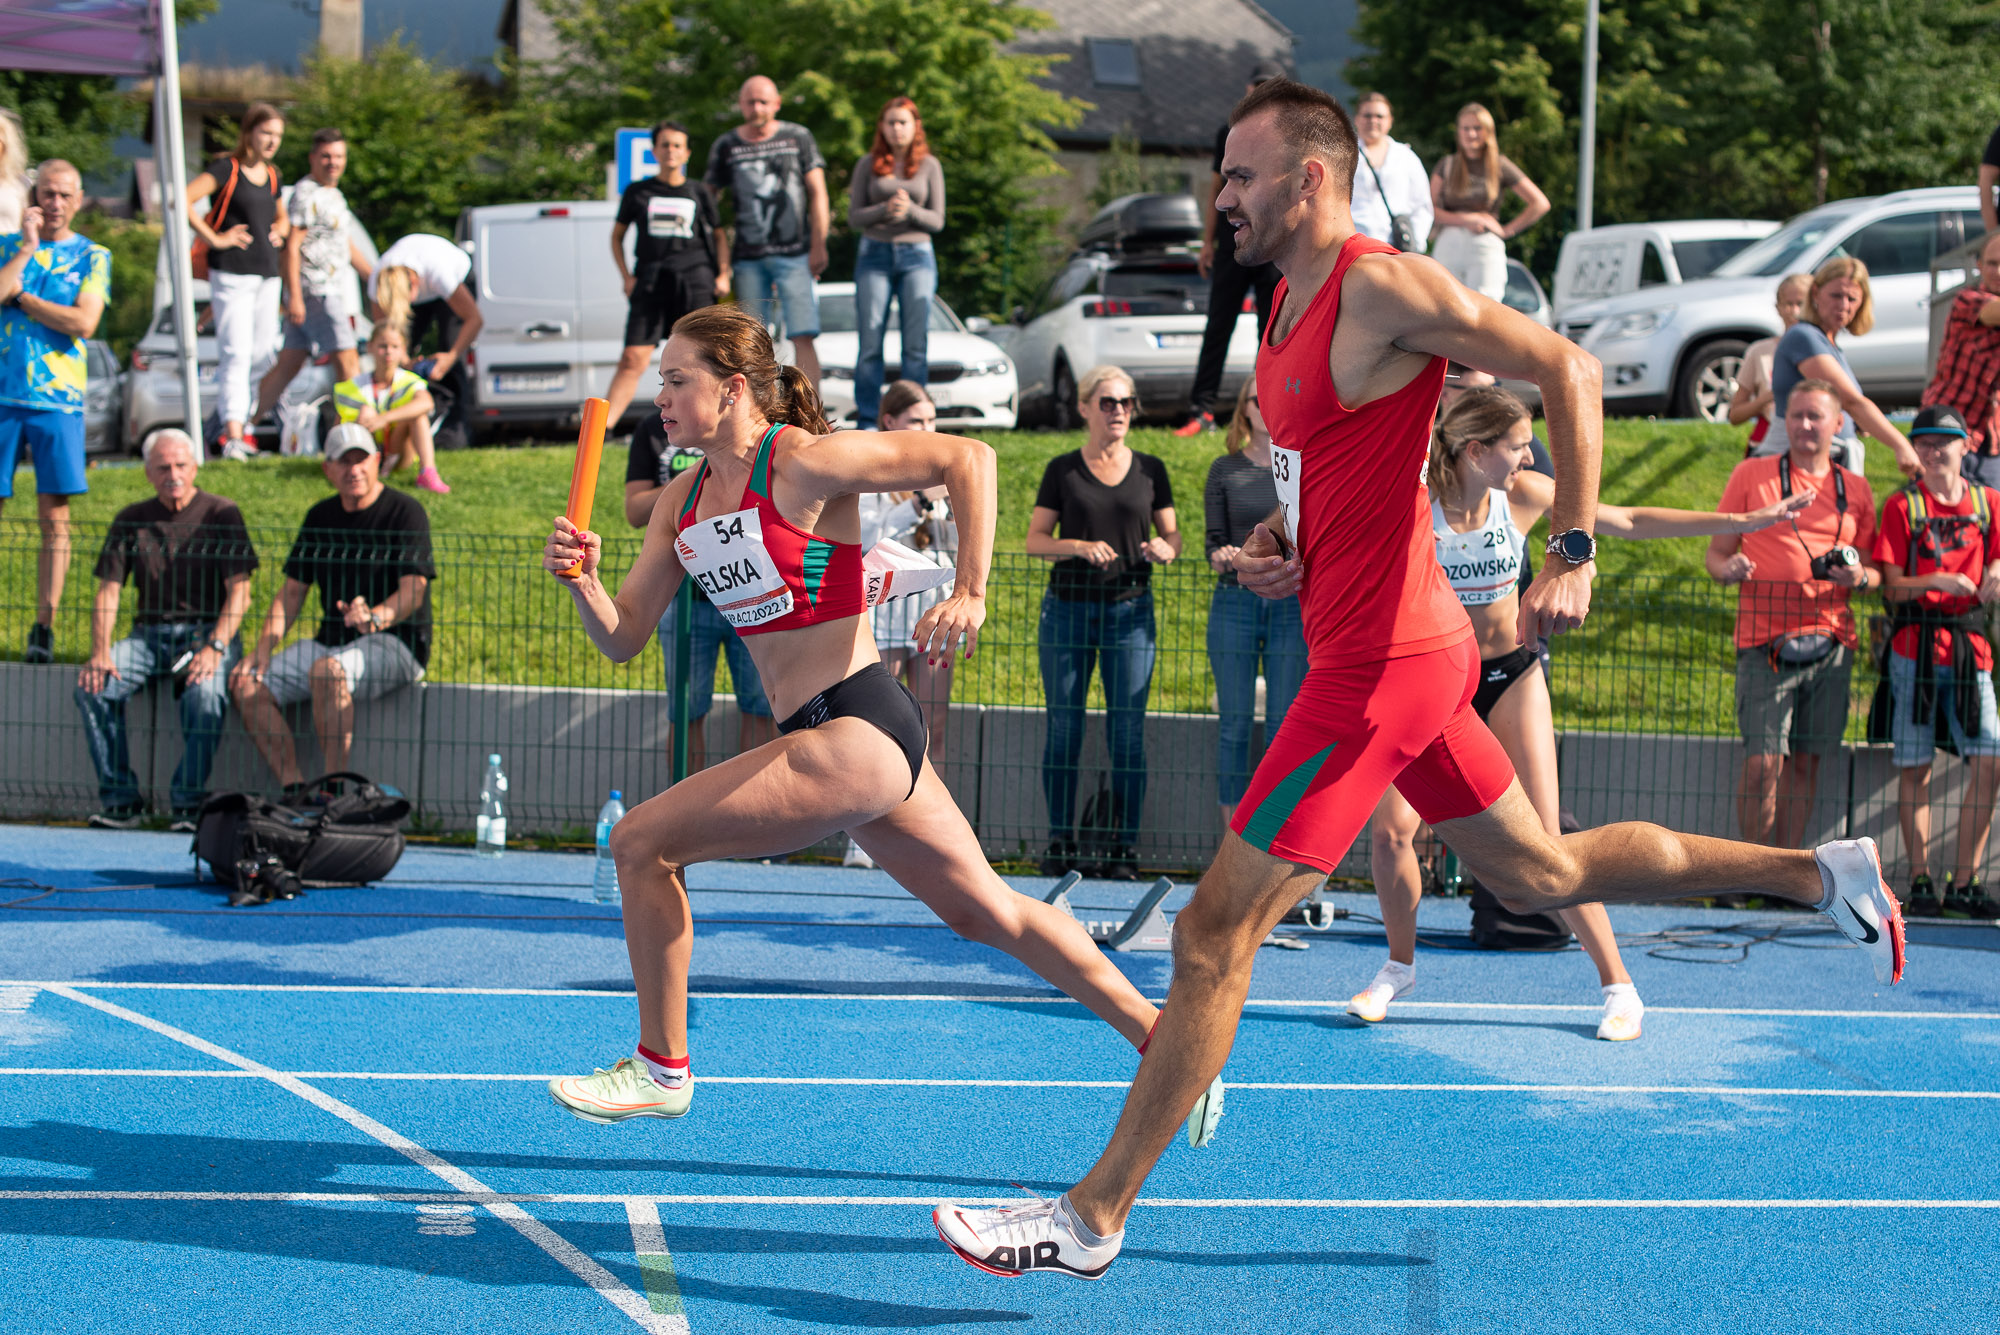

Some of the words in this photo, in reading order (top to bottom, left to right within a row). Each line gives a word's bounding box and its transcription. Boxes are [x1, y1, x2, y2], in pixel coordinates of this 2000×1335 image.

[1274, 451, 1290, 482] 53
[713, 517, 744, 545] 54
[1483, 528, 1505, 548] 28
[753, 602, 782, 622] 2022
[984, 1241, 1060, 1269] AIR
